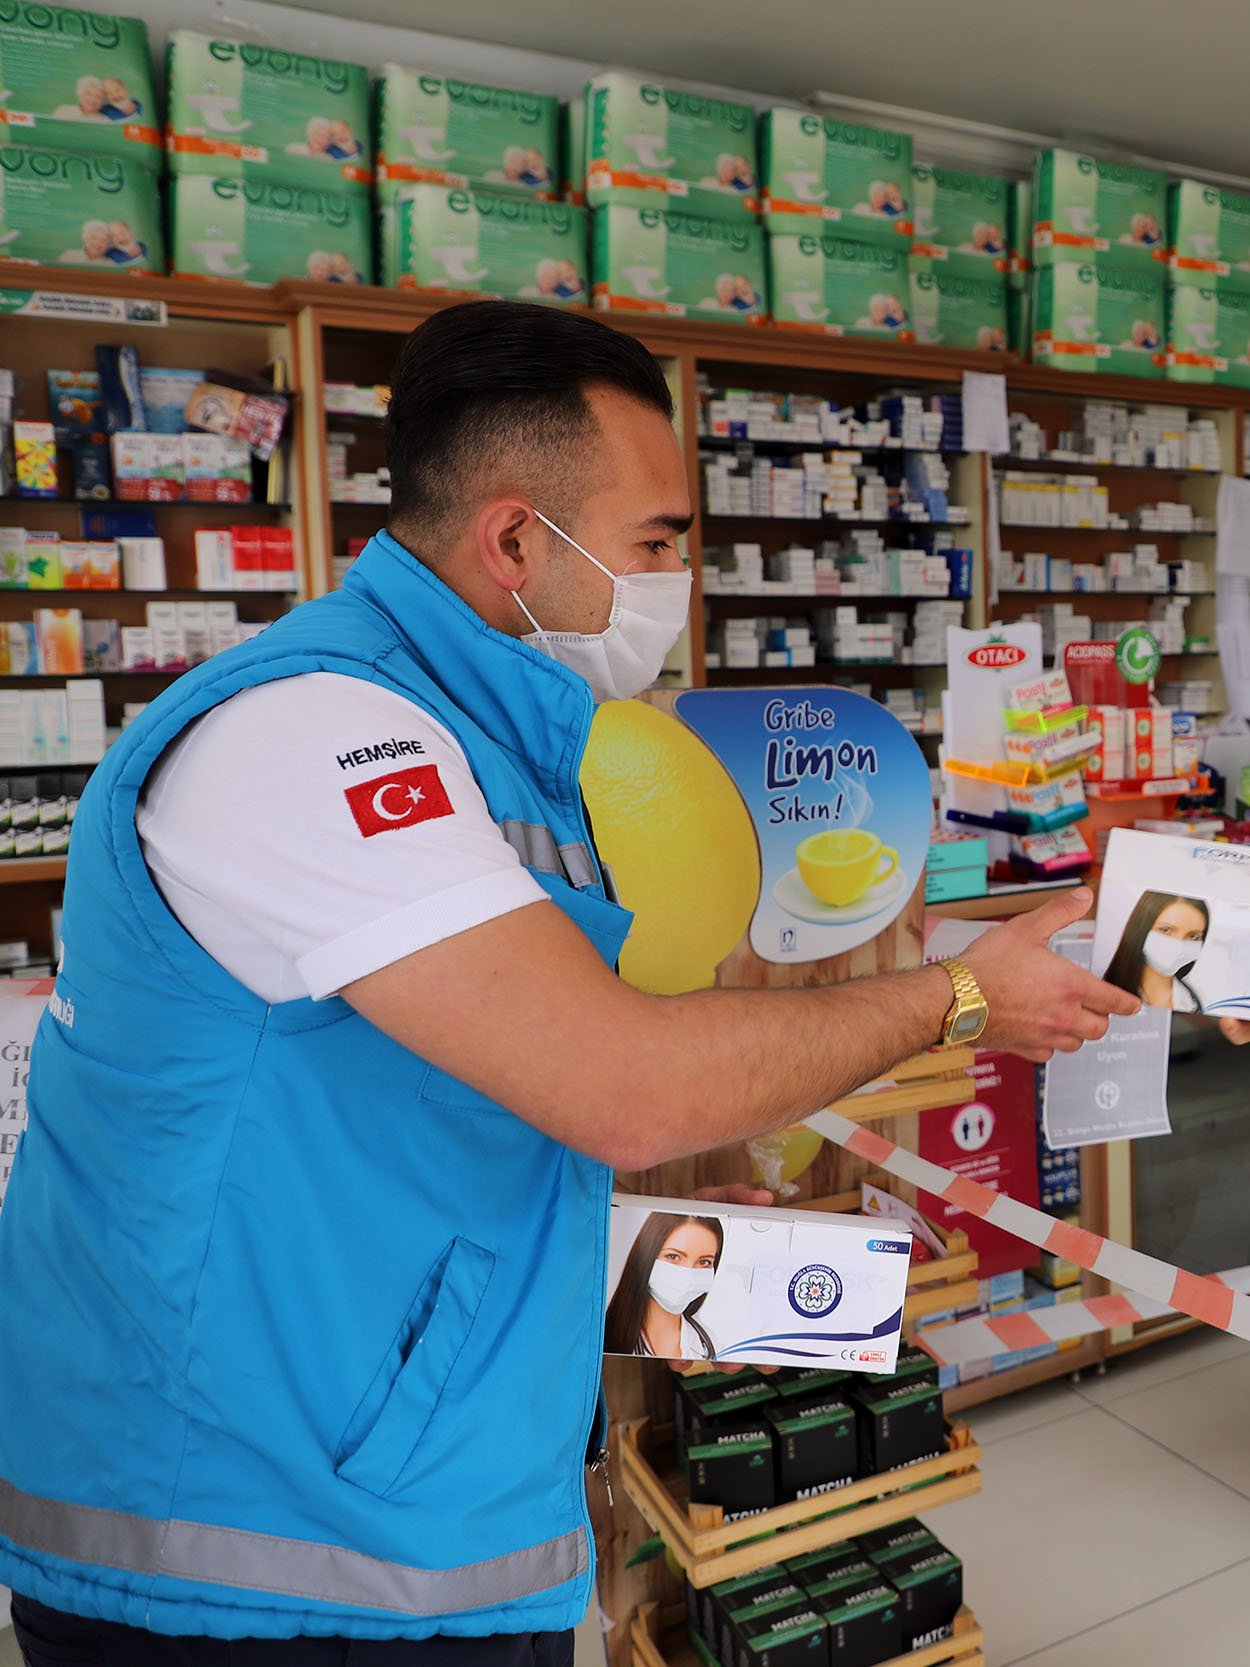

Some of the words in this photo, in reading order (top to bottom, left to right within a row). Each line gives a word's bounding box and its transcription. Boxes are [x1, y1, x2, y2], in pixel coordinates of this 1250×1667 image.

[0, 0, 120, 48] vony
[209, 40, 349, 94] evony
[419, 76, 541, 124] evony
[639, 84, 747, 132] evony
[0, 148, 123, 193] vony
[212, 177, 349, 227] evony
[448, 190, 571, 234] evony
[639, 208, 747, 252] evony
[765, 700, 834, 731] Gribe
[765, 738, 877, 790] Limon
[872, 1241, 884, 1251] 50
[883, 1244, 898, 1252] Adet
[723, 1382, 768, 1399] MATCHA
[887, 1381, 931, 1399] MATCHA
[798, 1401, 846, 1418] MATCHA
[717, 1430, 767, 1445] MATCHA
[888, 1528, 928, 1548] MATCHA
[826, 1561, 869, 1581] MATCHA
[911, 1551, 952, 1572] MATCHA
[753, 1584, 799, 1605] MATCHA
[845, 1585, 889, 1606] MATCHA
[771, 1610, 818, 1633] MATCHA
[912, 1622, 954, 1650] MATCH
